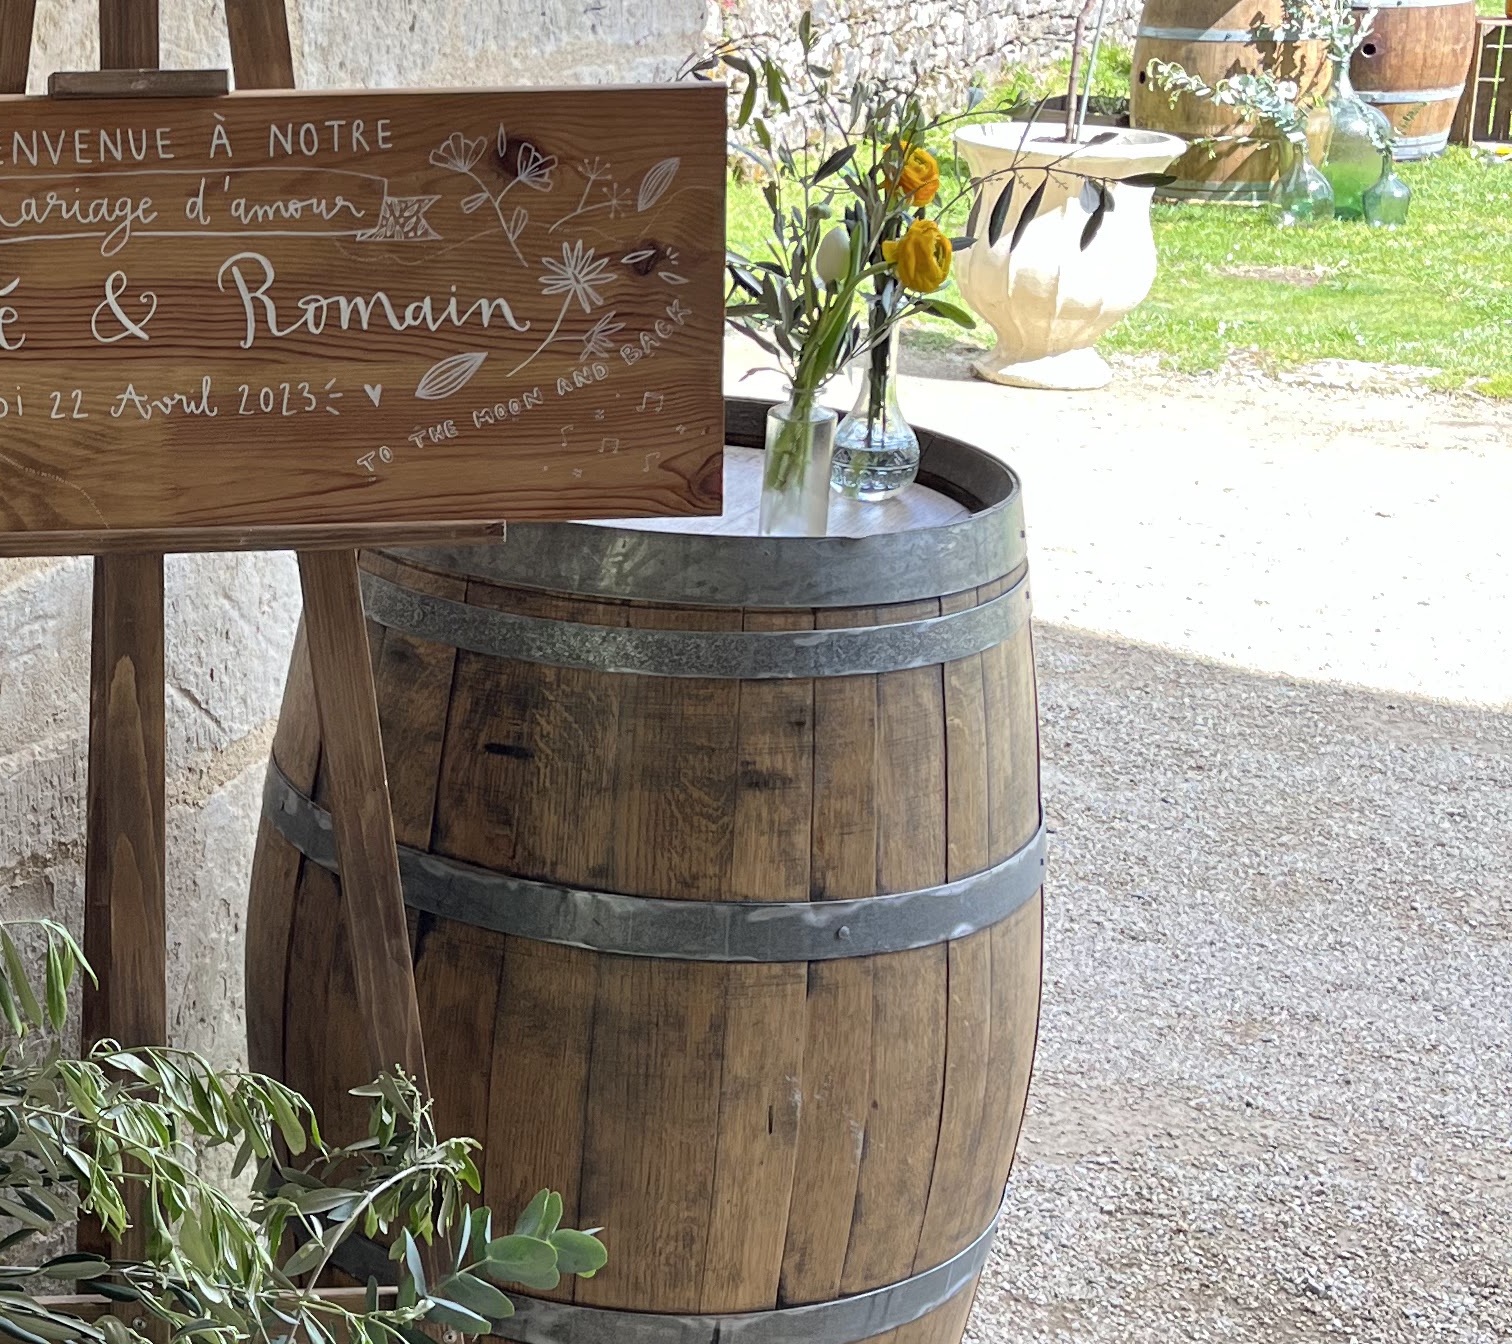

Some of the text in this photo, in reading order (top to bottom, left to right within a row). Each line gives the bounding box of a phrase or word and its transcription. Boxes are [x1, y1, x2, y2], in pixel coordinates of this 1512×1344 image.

[209, 112, 233, 159] À
[268, 118, 393, 158] NOTRE
[185, 175, 366, 226] d'amour
[91, 270, 158, 343] &
[217, 251, 531, 350] Romain
[48, 388, 89, 420] 22
[109, 375, 219, 420] Avril
[237, 381, 318, 416] 2023
[356, 298, 693, 473] TO THE MOON AND BACK
